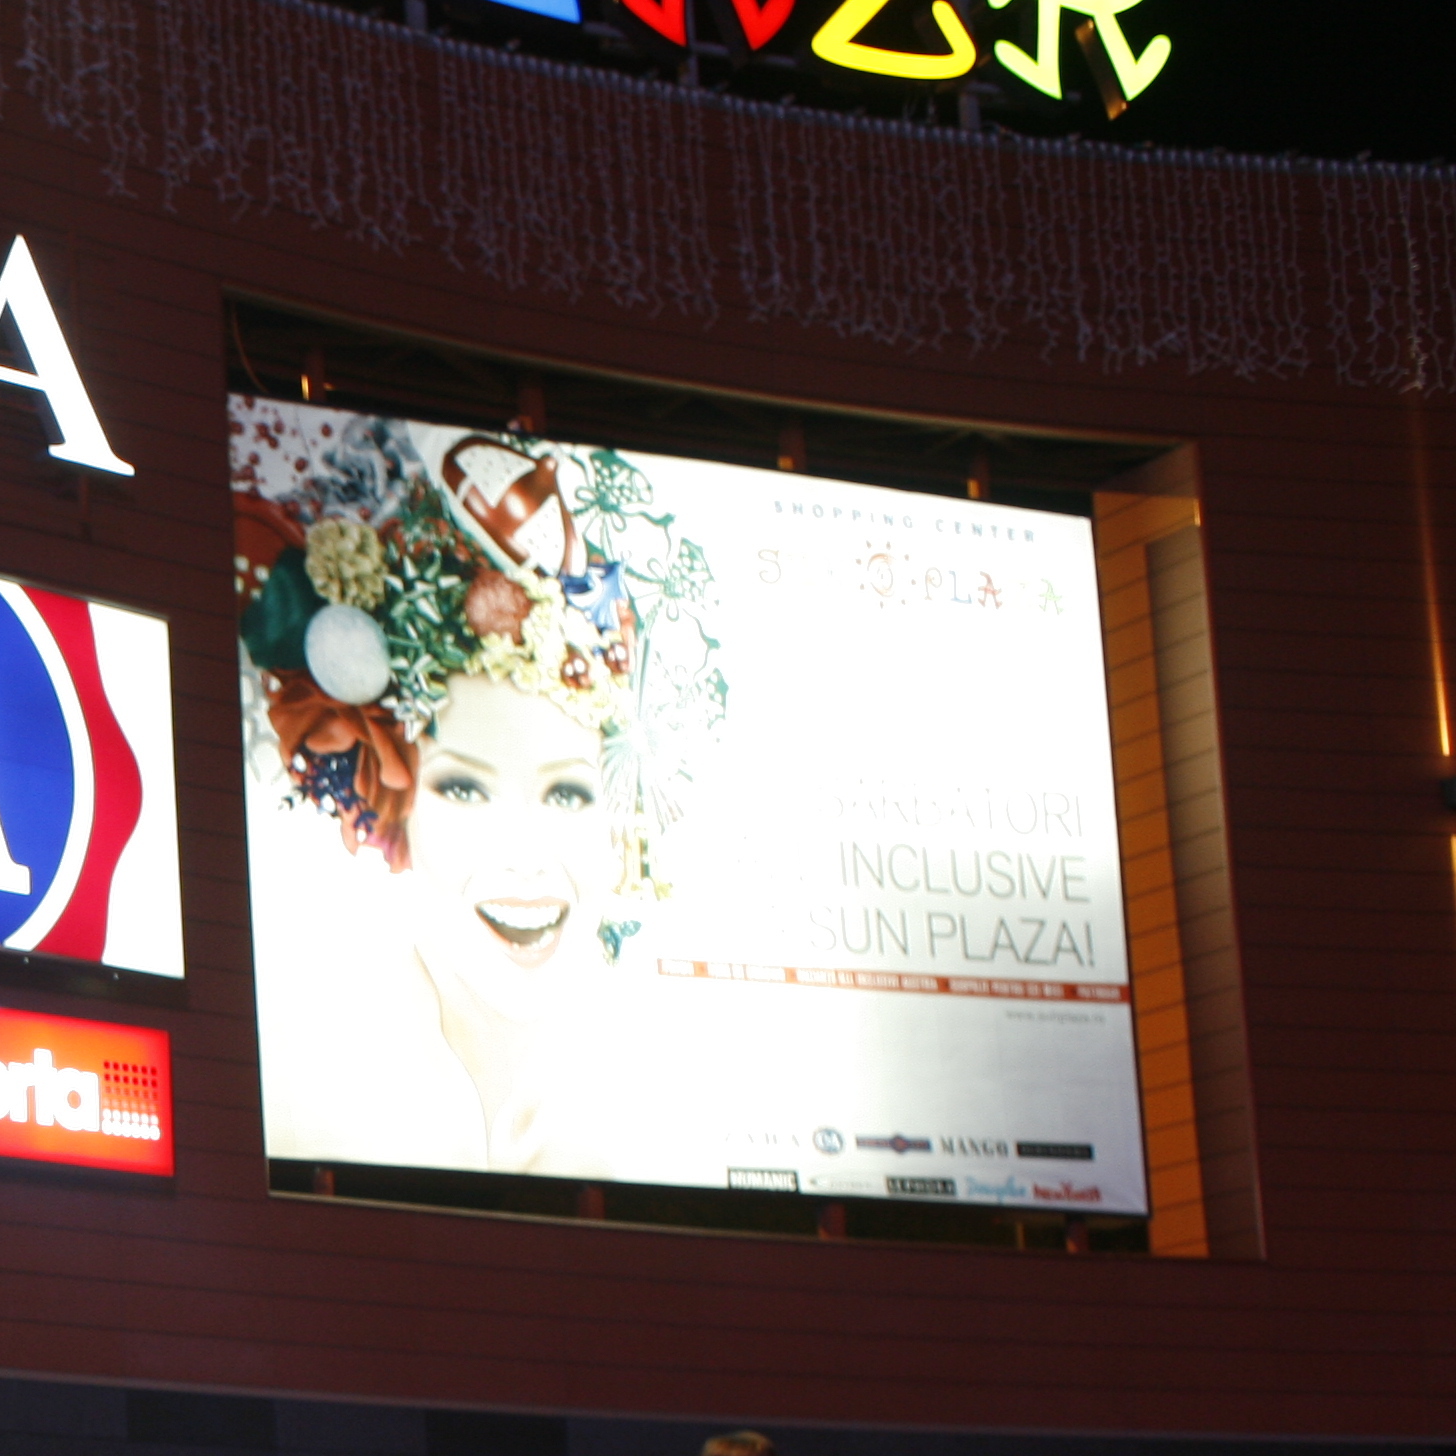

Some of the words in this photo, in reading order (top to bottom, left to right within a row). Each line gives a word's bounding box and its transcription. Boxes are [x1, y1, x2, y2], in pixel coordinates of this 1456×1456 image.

[839, 840, 1093, 904] INCLUSIVE
[809, 904, 911, 958] SUN
[925, 911, 1096, 968] PLAZA!
[941, 1135, 1009, 1159] MANGO
